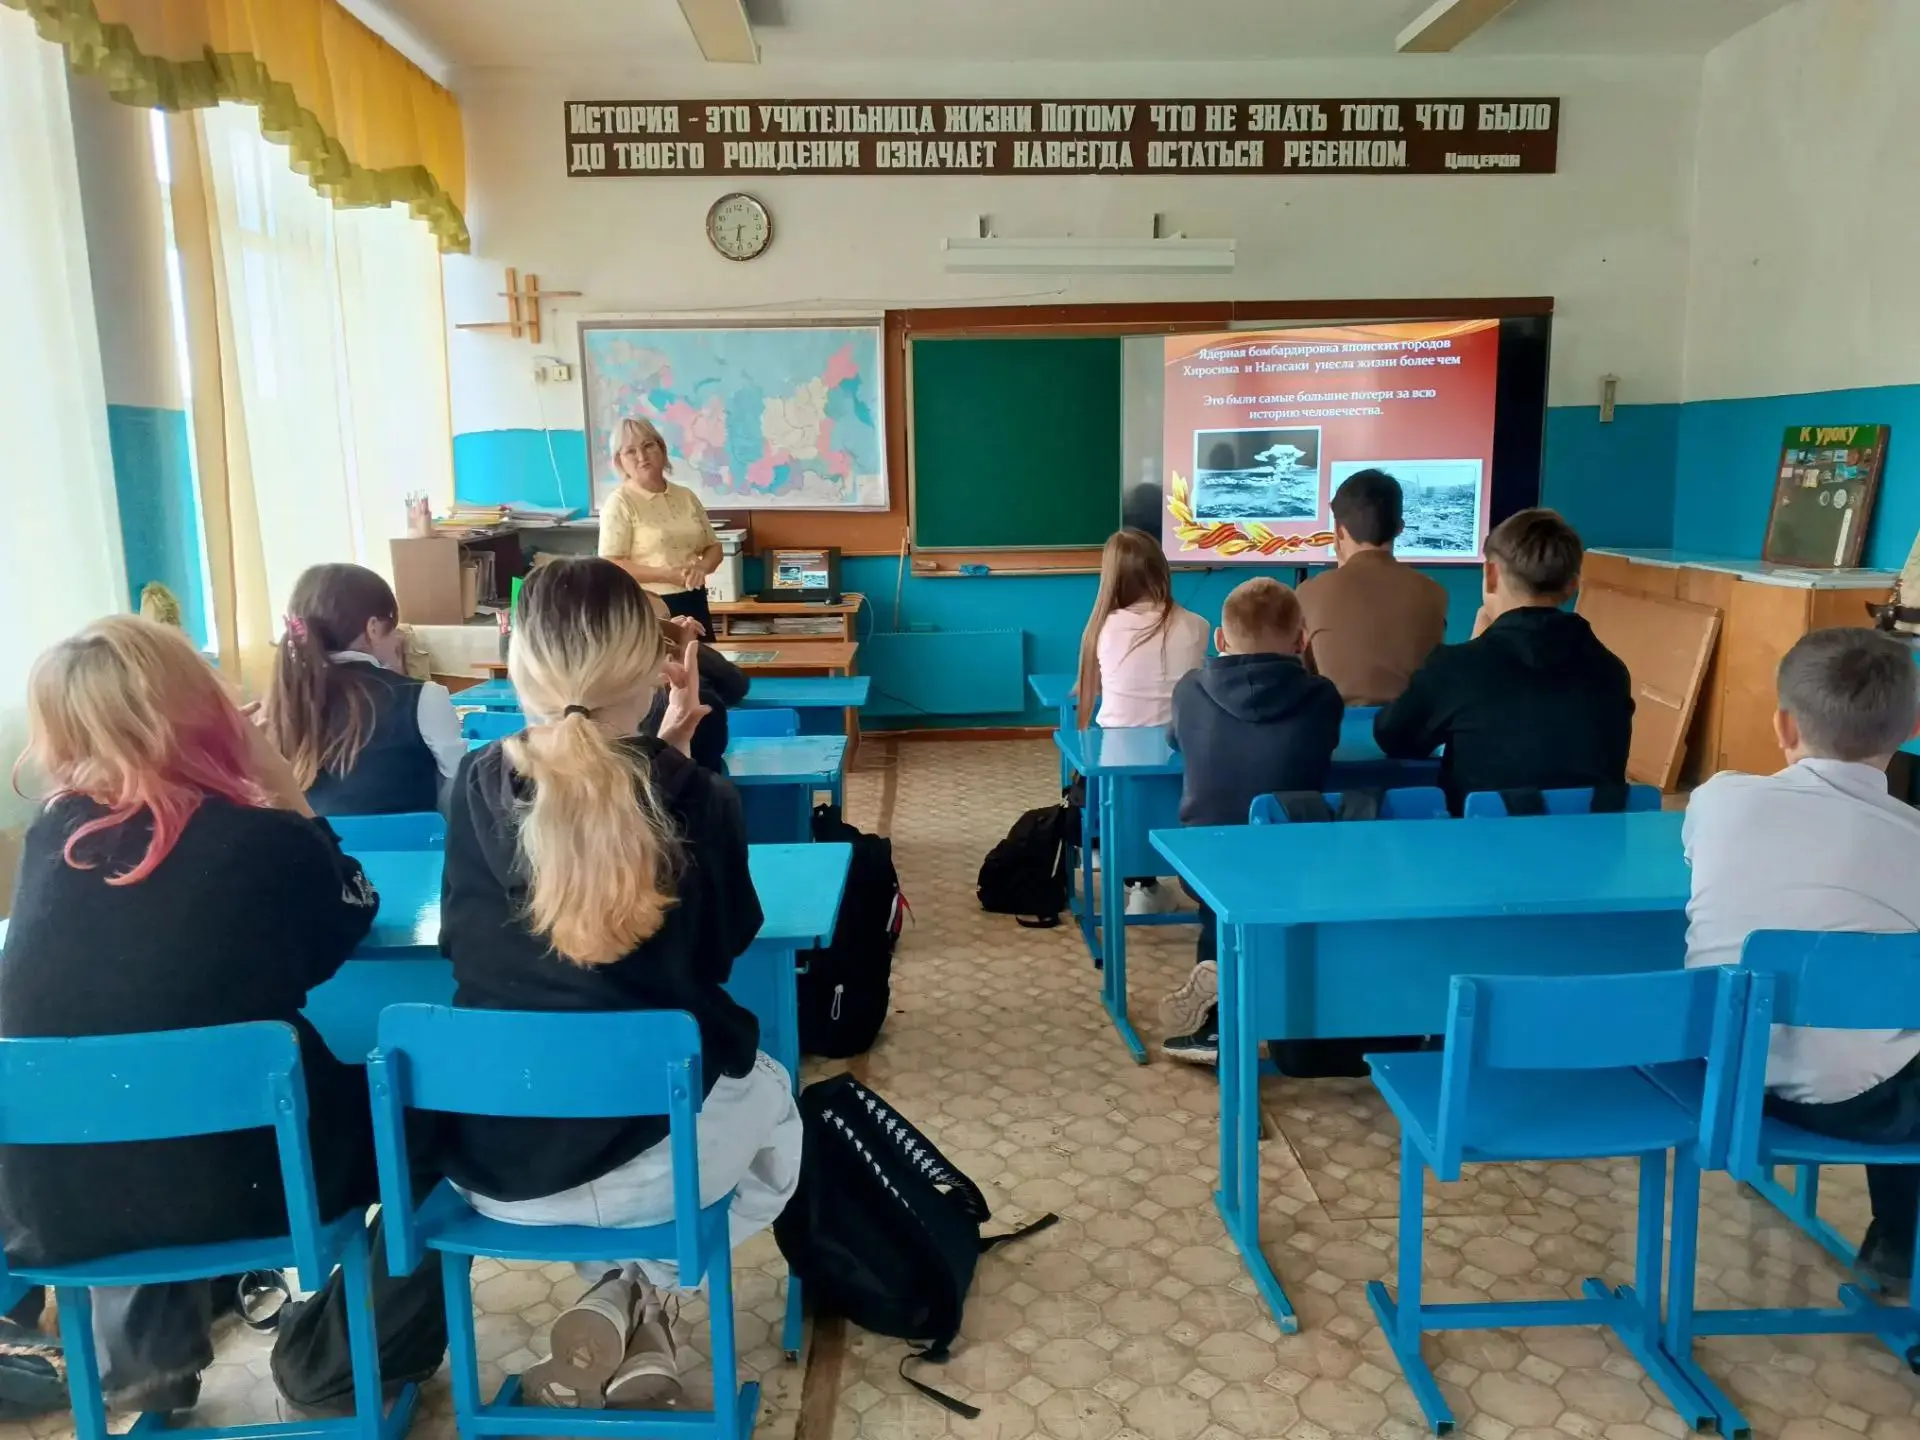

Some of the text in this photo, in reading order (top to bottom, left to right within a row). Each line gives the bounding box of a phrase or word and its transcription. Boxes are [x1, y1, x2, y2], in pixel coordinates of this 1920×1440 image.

[570, 104, 680, 134] ИСТОРИЯ
[705, 106, 750, 133] ЭТО
[758, 105, 935, 134] УЧИТЕЛЬНИЦА
[1041, 103, 1136, 132] ПОТОМУ
[1150, 105, 1196, 132] ЧТО
[1205, 105, 1237, 131] НЕ
[1248, 104, 1327, 131] ЗНАТЬ
[1416, 104, 1465, 131] ЧТО
[1478, 103, 1551, 133] БЫЛО
[571, 143, 606, 172] ДО
[613, 142, 704, 169] ТВОЕГО
[723, 141, 860, 171] РОЖДЕНИЯ
[876, 141, 997, 168] ОЗНАЧАЕТ
[1013, 140, 1134, 169] НАВСЕГДА
[1147, 140, 1264, 168] ОСТАТЬСЯ
[1199, 339, 1452, 361] Ядерная бомбардировка японских городов
[1183, 365, 1240, 379] Хиросима
[1255, 361, 1309, 373] Нагасаки
[1315, 359, 1354, 373] унесла
[1357, 358, 1397, 368] жизни
[1399, 355, 1436, 367] более
[1437, 355, 1461, 365] чем
[1203, 388, 1437, 406] Это были самые большие потери за всю
[1249, 406, 1385, 421] историю человечества.
